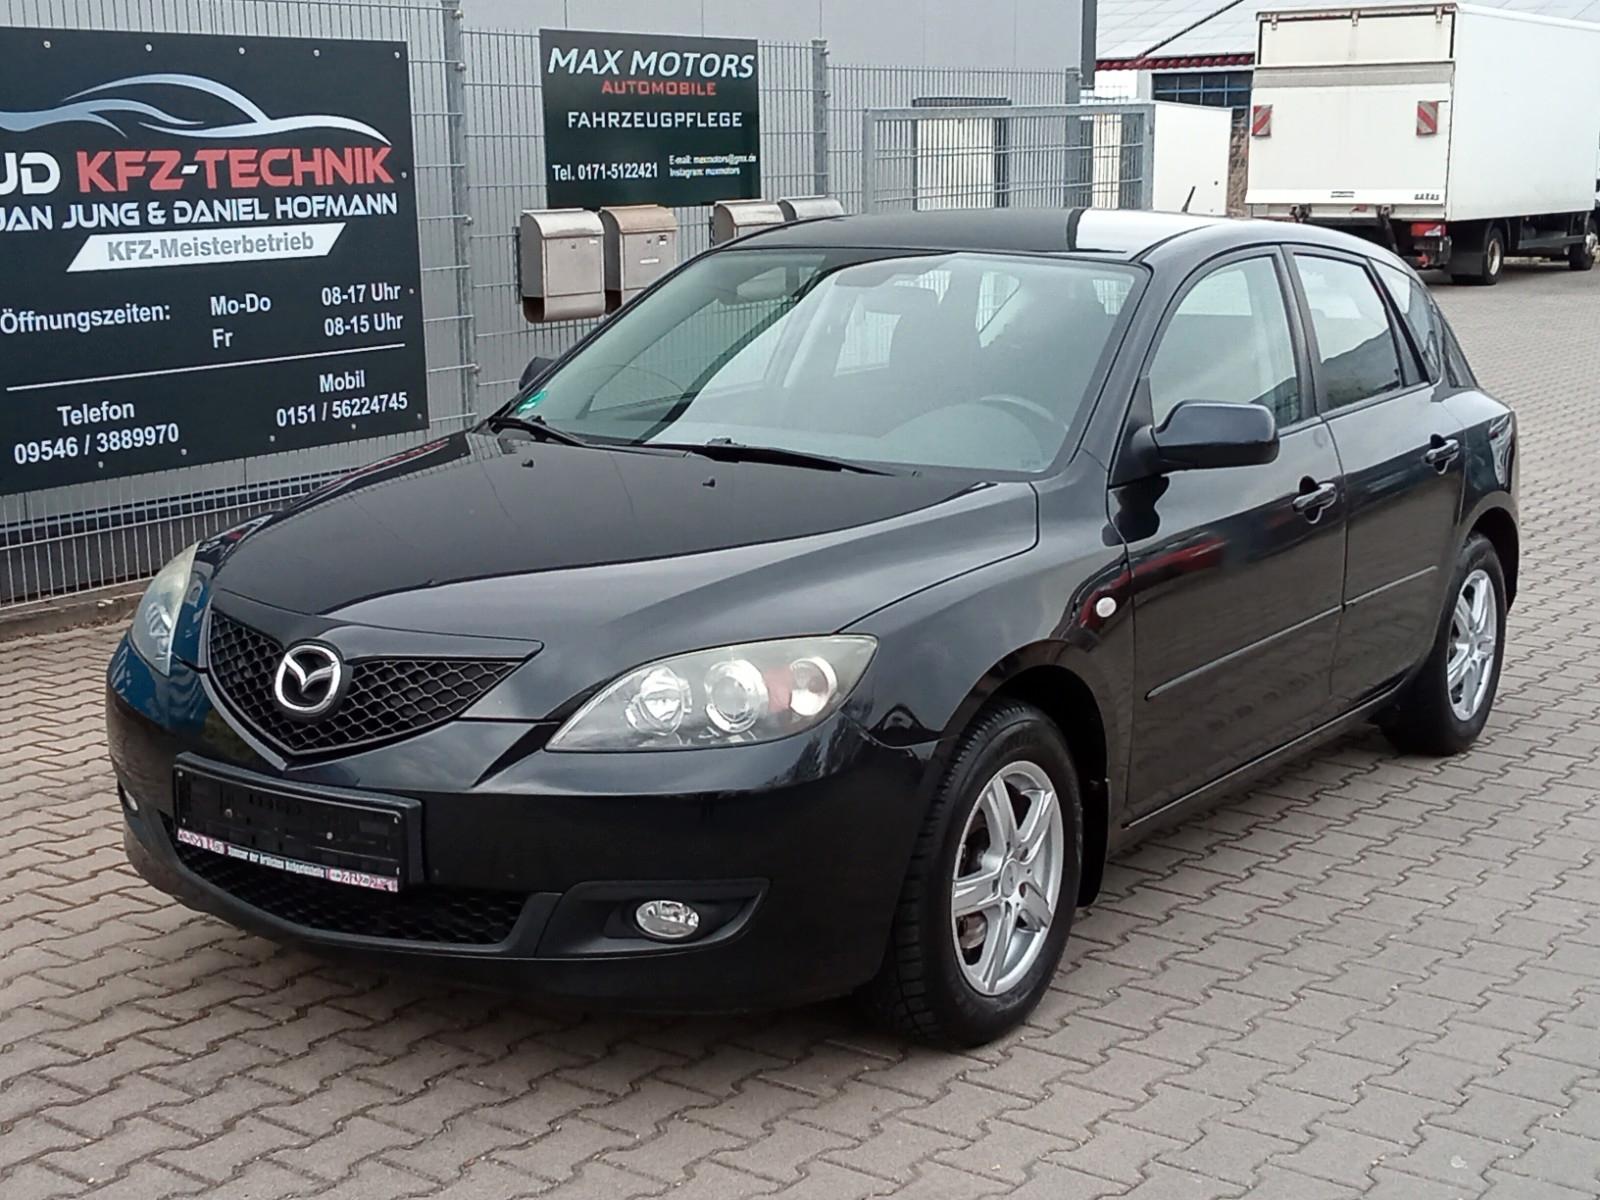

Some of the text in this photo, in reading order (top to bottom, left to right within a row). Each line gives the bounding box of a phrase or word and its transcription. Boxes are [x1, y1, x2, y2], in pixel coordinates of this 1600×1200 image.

[548, 48, 754, 78] MAX MOTORS
[602, 80, 717, 96] AUTOMOBILE
[568, 112, 742, 128] FAHRZEUGPFLEGE
[76, 147, 395, 193] KFZ-TECHNIK
[552, 162, 658, 181] Tel. 0171-5122421
[61, 202, 140, 229] JUNG
[148, 201, 166, 225] &
[172, 198, 269, 224] DANIEL
[276, 192, 398, 218] HOFMANN
[107, 231, 315, 263] KFZ-Meisterbetrieb
[0, 283, 401, 334] Öffnungszeiten: Mo-Do 08-17 Uhr
[212, 313, 403, 348] Fr 08-15 Uhr
[318, 370, 366, 394] Mobil
[58, 401, 135, 427] Telefon
[276, 404, 317, 428] 0151
[332, 392, 408, 420] 56224745
[14, 436, 78, 465] 09546
[96, 423, 180, 453] 3889970
